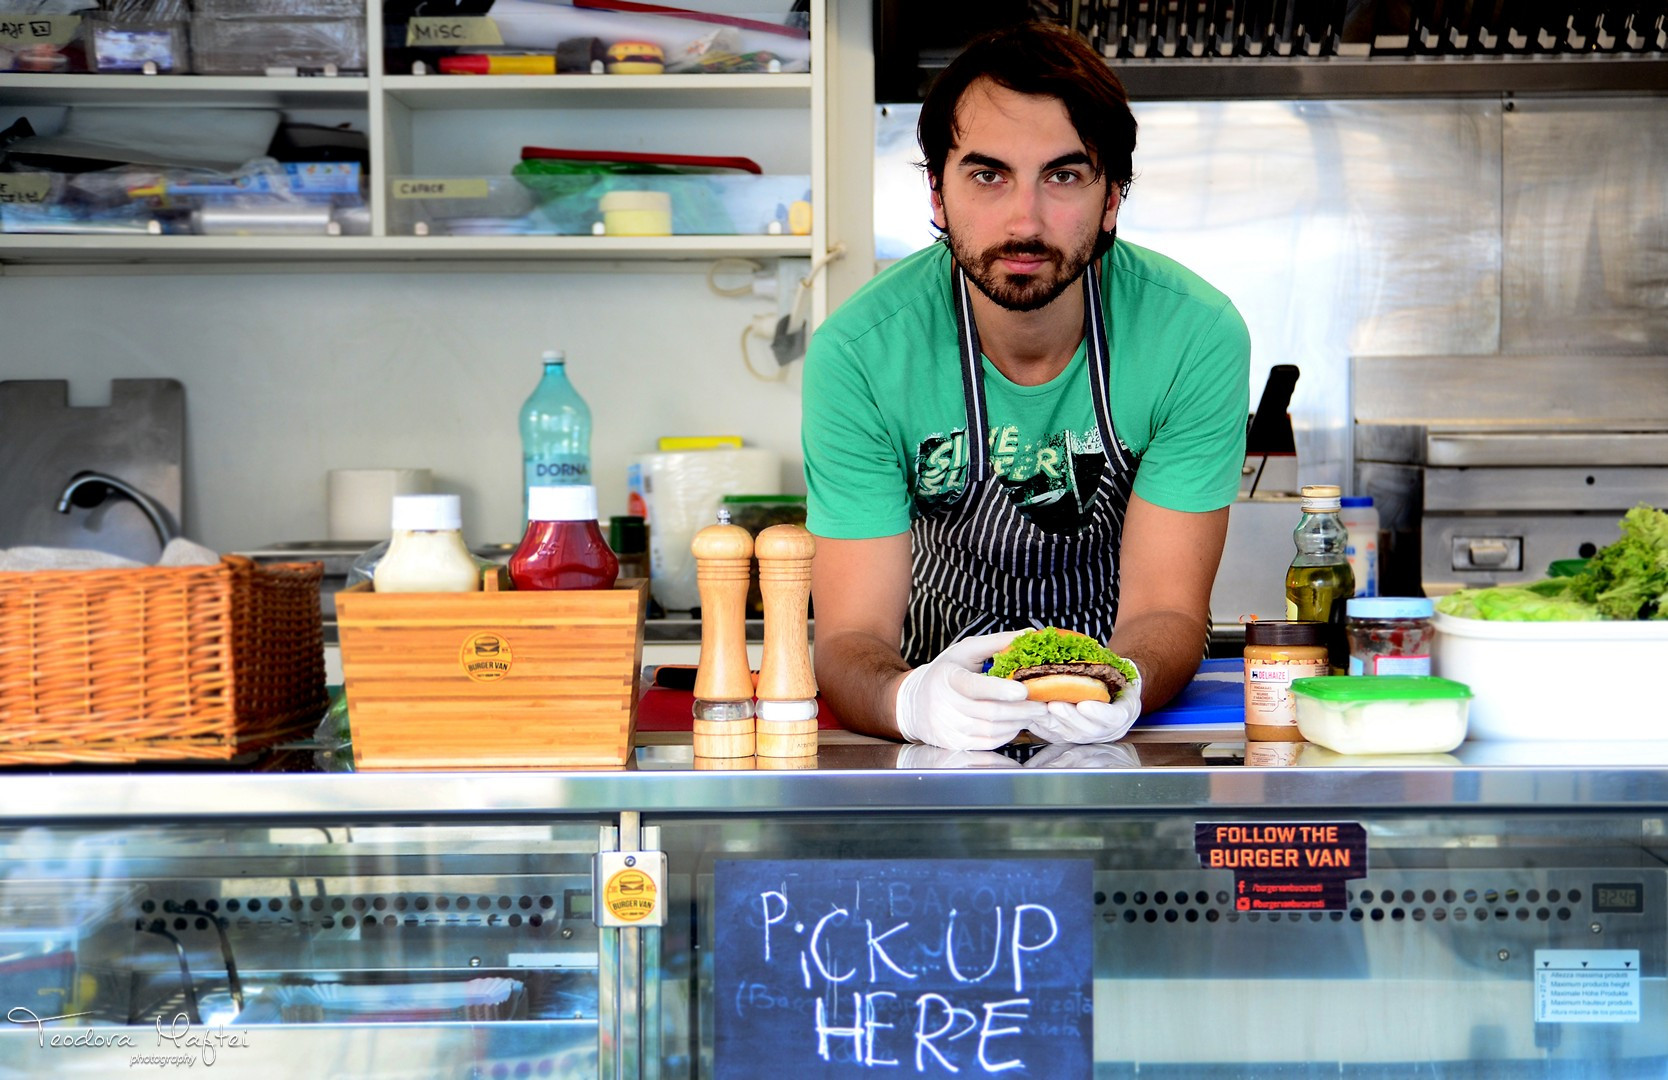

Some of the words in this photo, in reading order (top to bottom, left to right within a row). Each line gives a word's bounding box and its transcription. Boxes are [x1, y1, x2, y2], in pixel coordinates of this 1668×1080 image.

[536, 463, 589, 477] DORNA
[468, 661, 494, 672] BURGER
[495, 661, 509, 671] VAN
[1259, 671, 1286, 680] DELHAIZE
[1216, 826, 1296, 843] FOLLOW
[1299, 826, 1339, 843] THE
[1210, 848, 1299, 868] BURGER
[1305, 848, 1350, 868] VAN
[612, 899, 638, 911] BURGER
[639, 900, 653, 910] VAN
[946, 903, 1058, 992] UP
